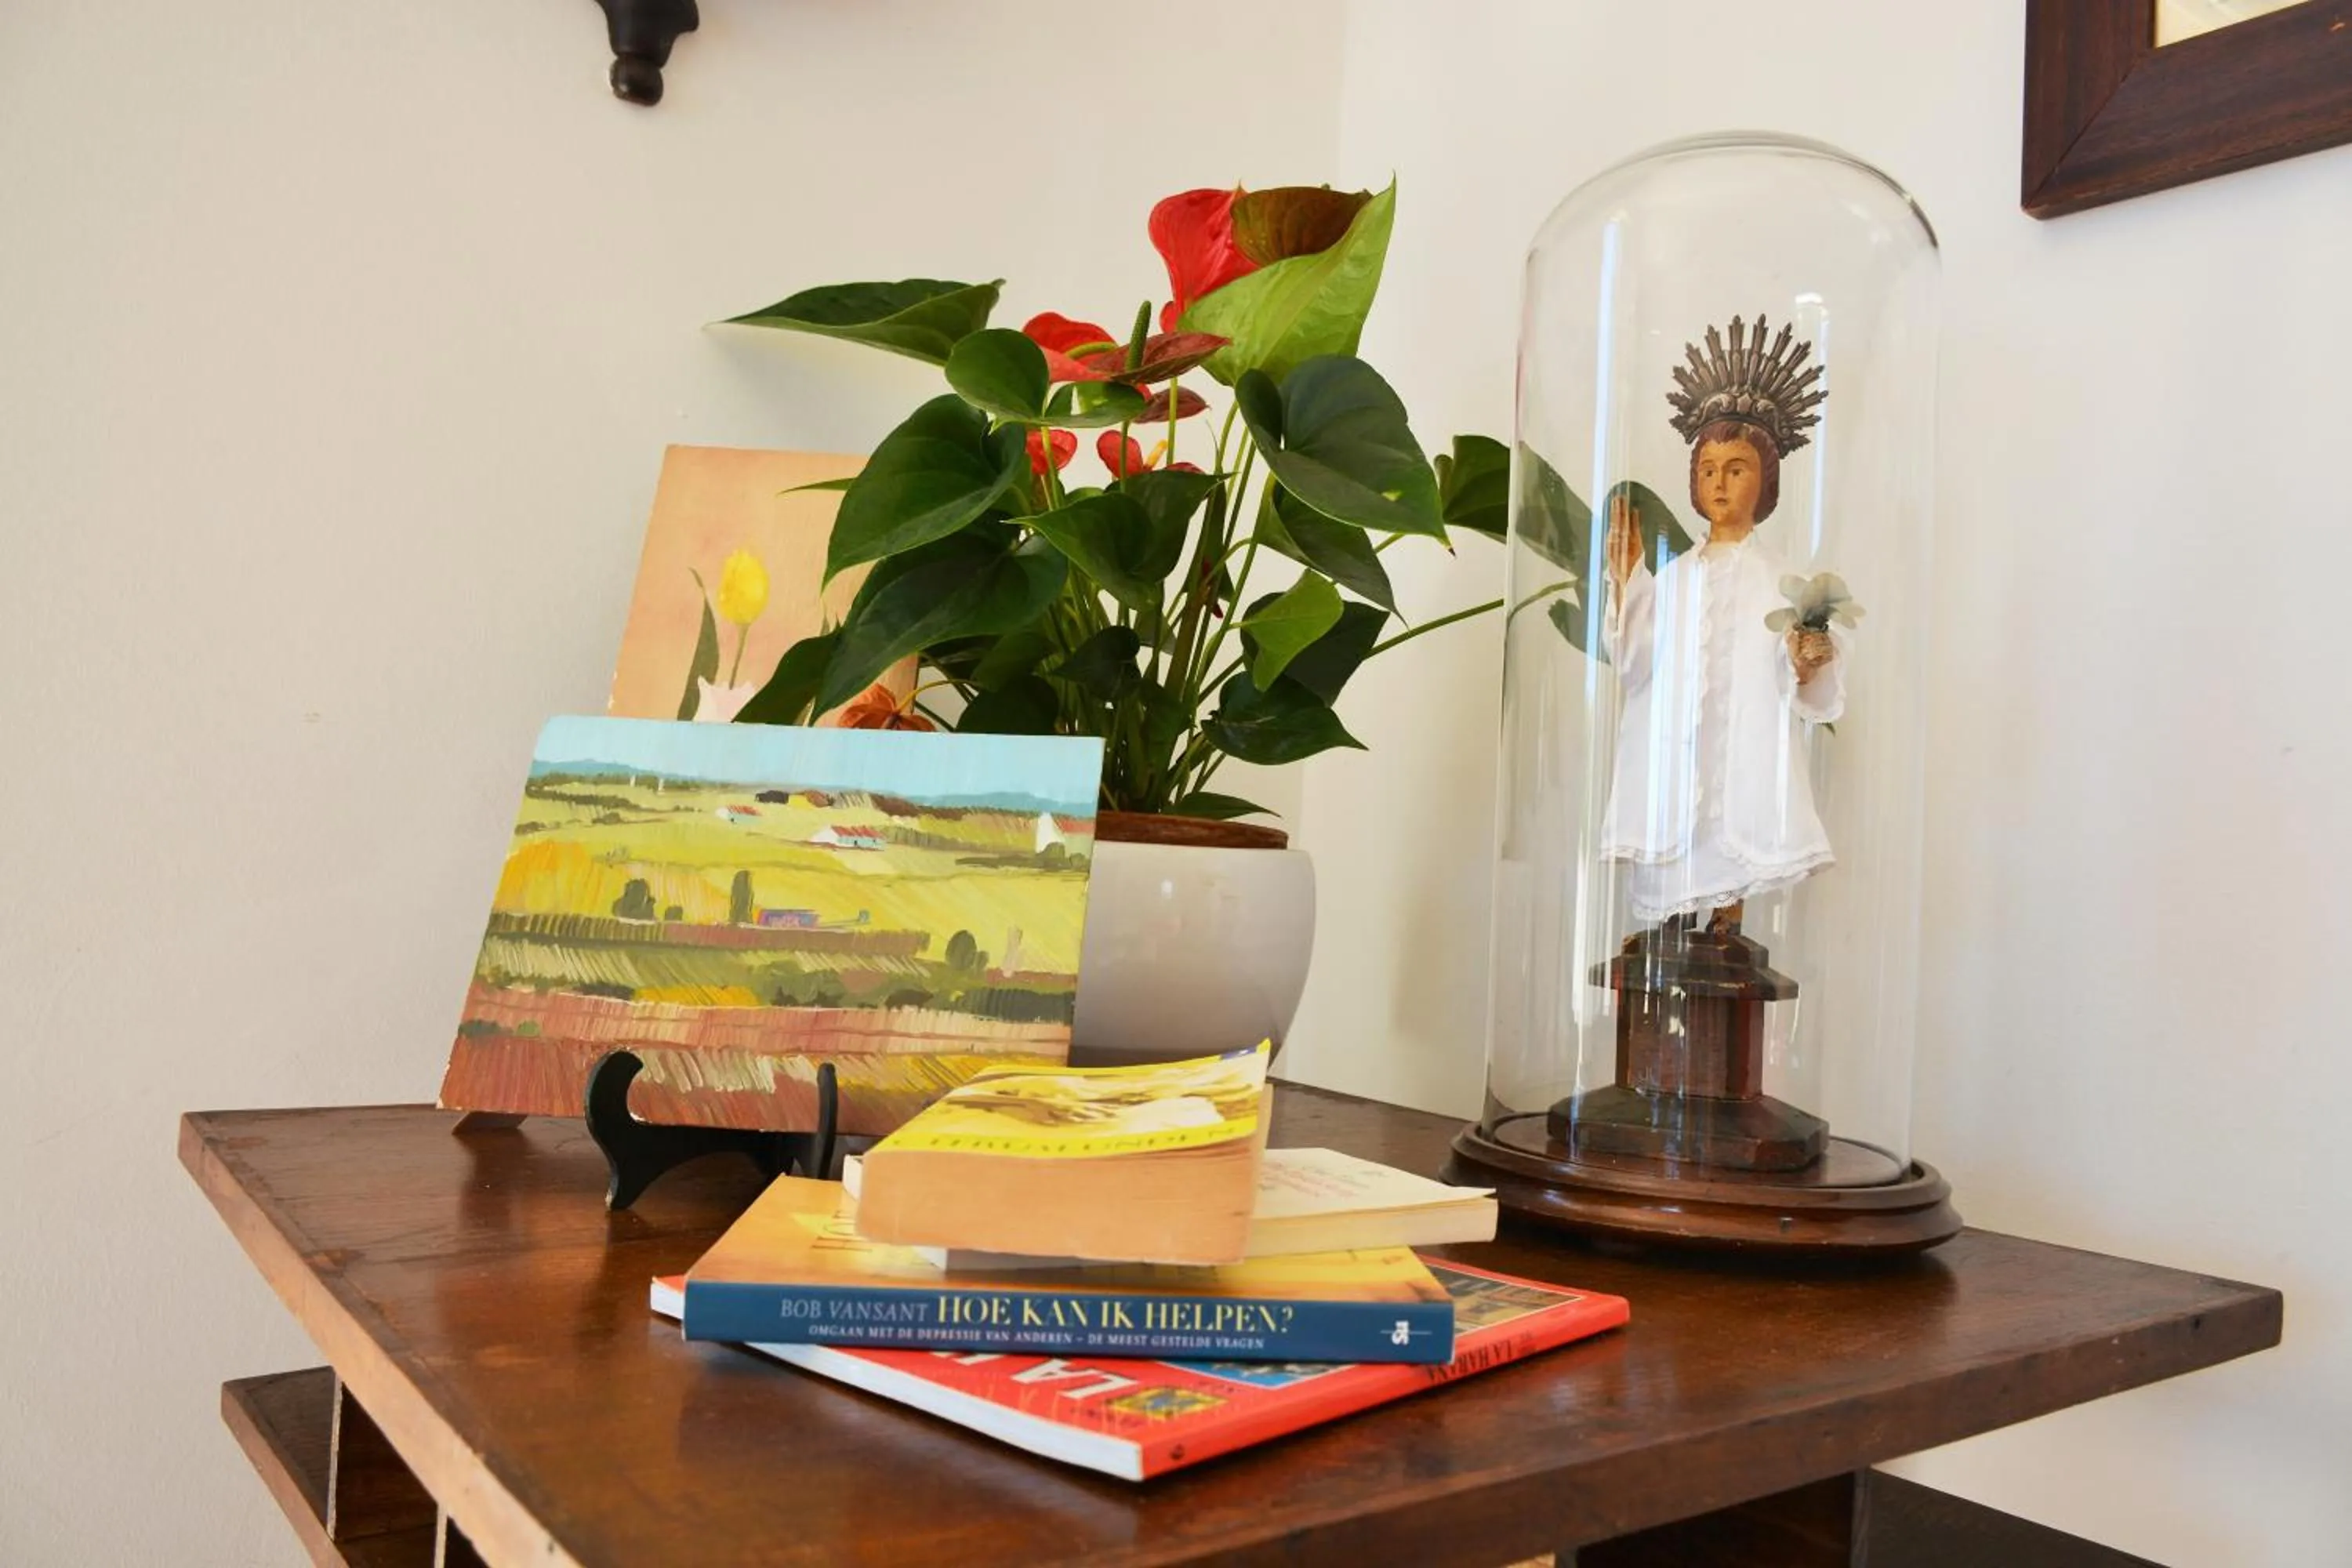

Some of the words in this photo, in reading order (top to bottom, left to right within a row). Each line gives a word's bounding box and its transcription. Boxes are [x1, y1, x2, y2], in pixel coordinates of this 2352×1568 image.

[781, 1298, 822, 1319] BOB
[829, 1300, 929, 1322] VANSANT
[938, 1295, 1012, 1325] HOE
[1022, 1298, 1091, 1327] KAN
[1101, 1301, 1134, 1329] IK
[1145, 1302, 1294, 1333] HELPEN?
[808, 1325, 864, 1337] OMGAAN
[869, 1327, 893, 1338] MET
[900, 1328, 913, 1339] DE
[917, 1328, 982, 1341] DEPRESSIE
[985, 1331, 1011, 1341] VAN
[1014, 1332, 1073, 1344] ANDEREN
[1088, 1334, 1102, 1345] DE
[1108, 1334, 1147, 1346] MEEST
[1151, 1335, 1211, 1348] GESTELDE
[1215, 1336, 1265, 1349] VRAGEN
